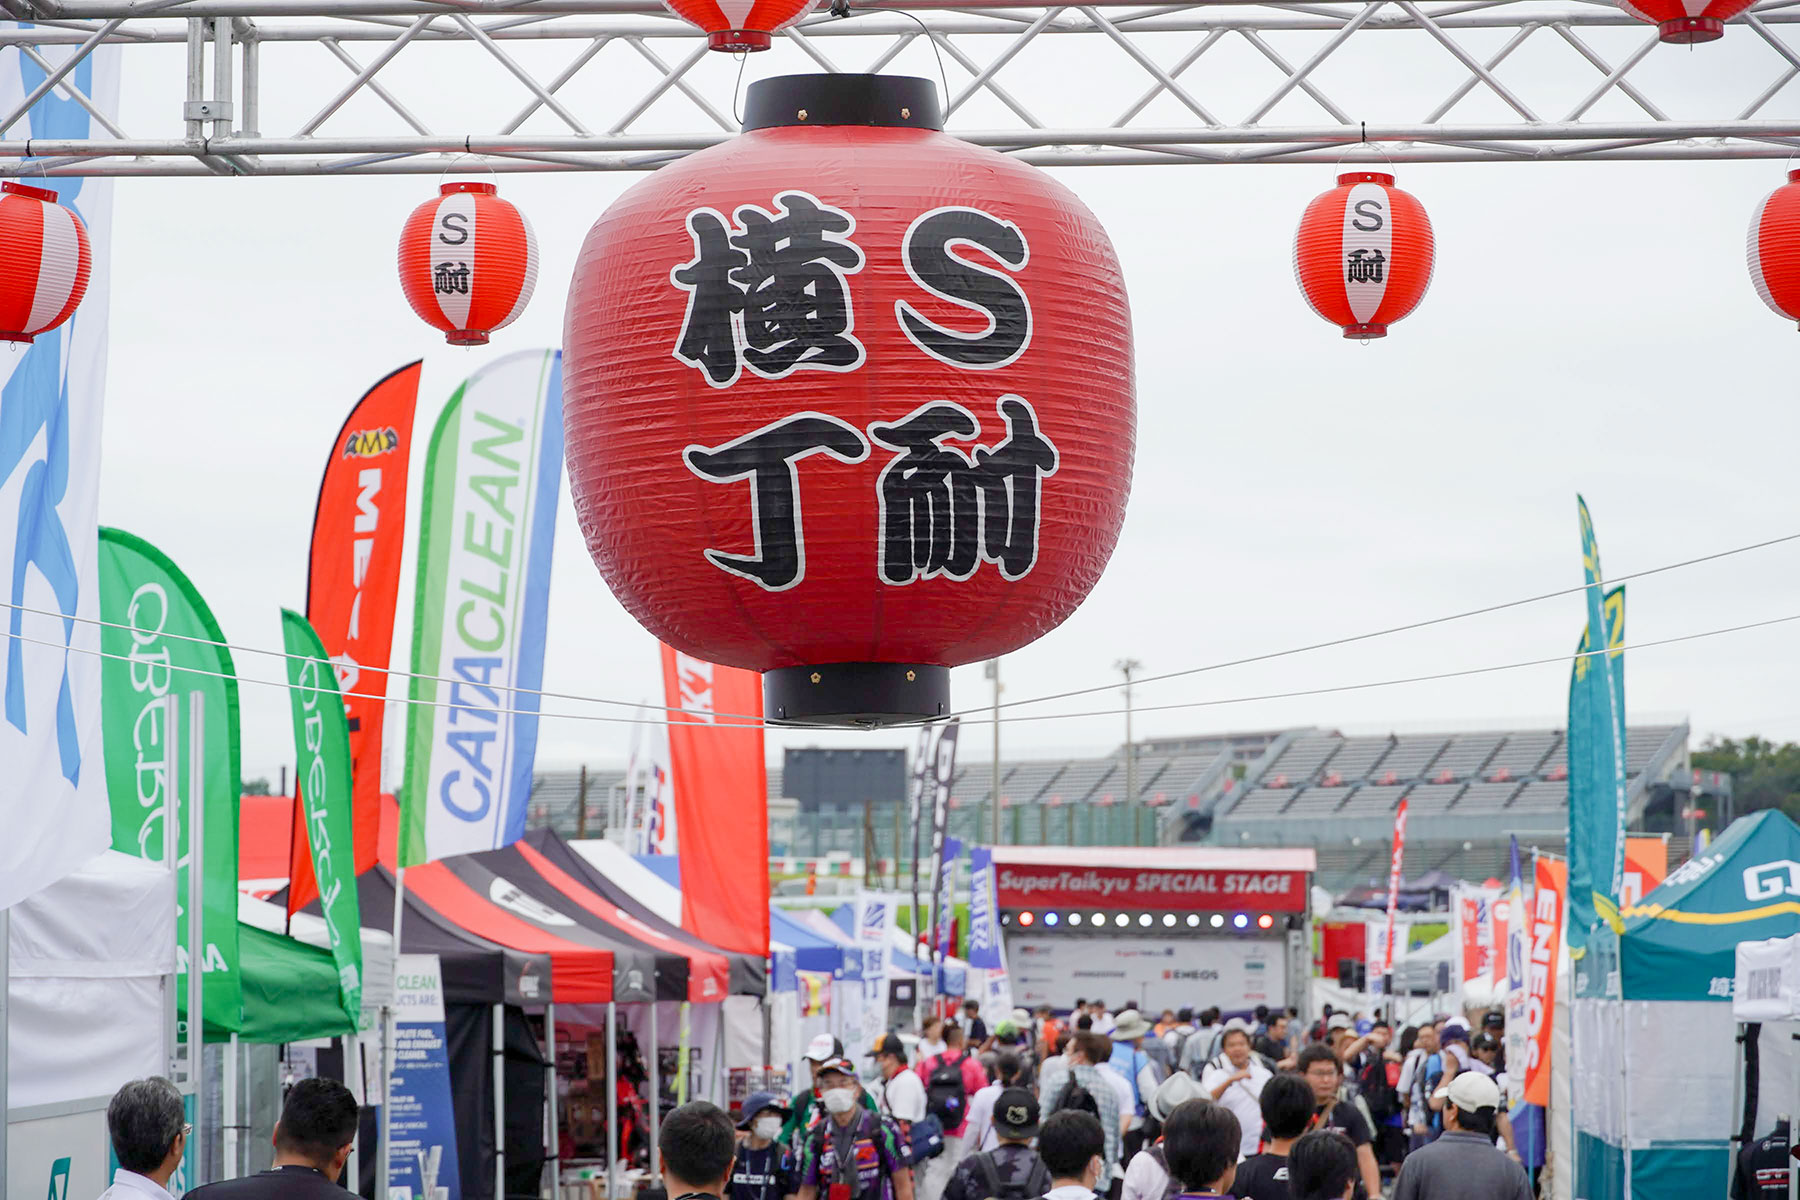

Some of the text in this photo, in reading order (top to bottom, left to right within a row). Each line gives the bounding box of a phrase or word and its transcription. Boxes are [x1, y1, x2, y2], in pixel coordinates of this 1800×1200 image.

[440, 411, 526, 823] CATACLEAN
[999, 870, 1292, 894] SuperTaikyu SPECIAL STAGE
[1173, 969, 1219, 980] ENEOS
[1525, 888, 1558, 1069] ENEOS
